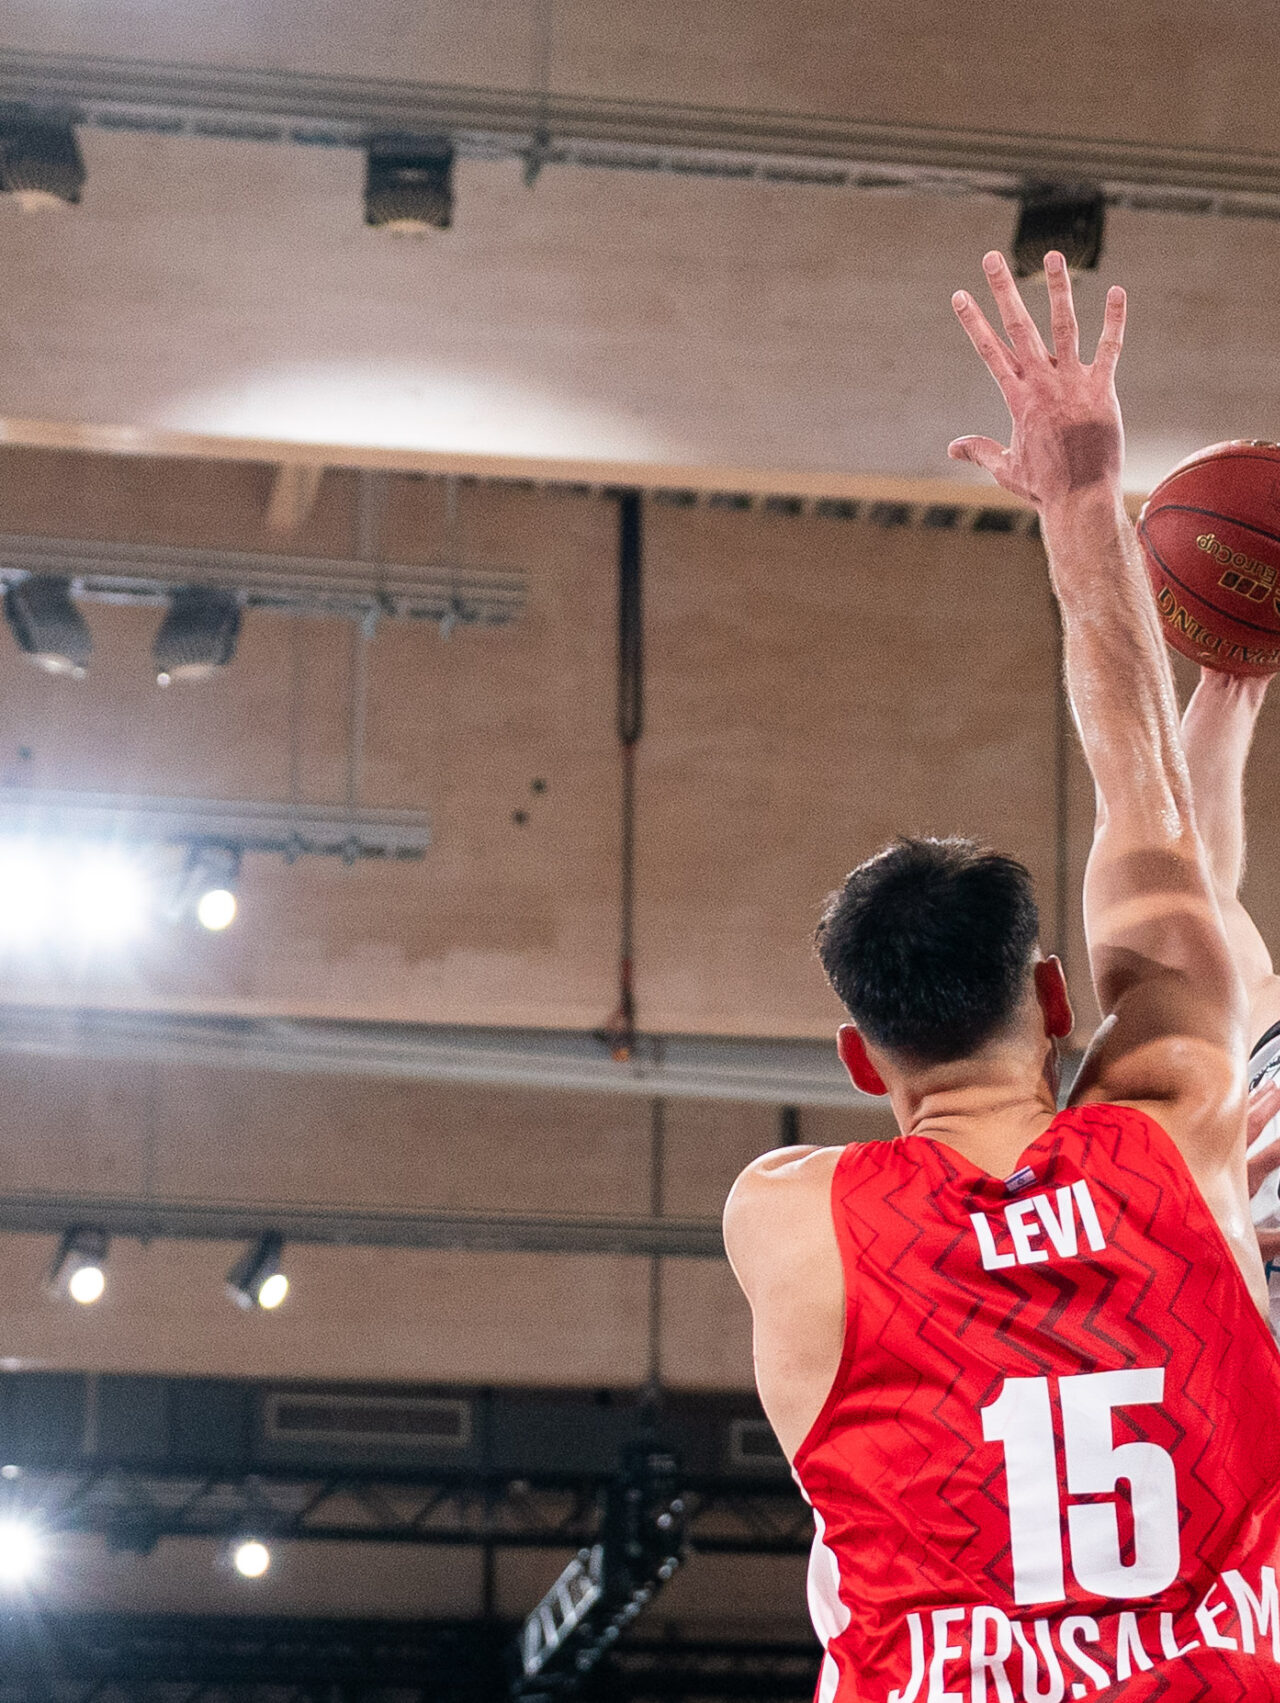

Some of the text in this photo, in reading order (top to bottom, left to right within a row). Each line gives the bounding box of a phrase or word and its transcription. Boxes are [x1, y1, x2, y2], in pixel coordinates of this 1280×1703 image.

[1196, 533, 1278, 587] EuroCup
[969, 1180, 1106, 1271] LEVI
[980, 1367, 1181, 1605] 15
